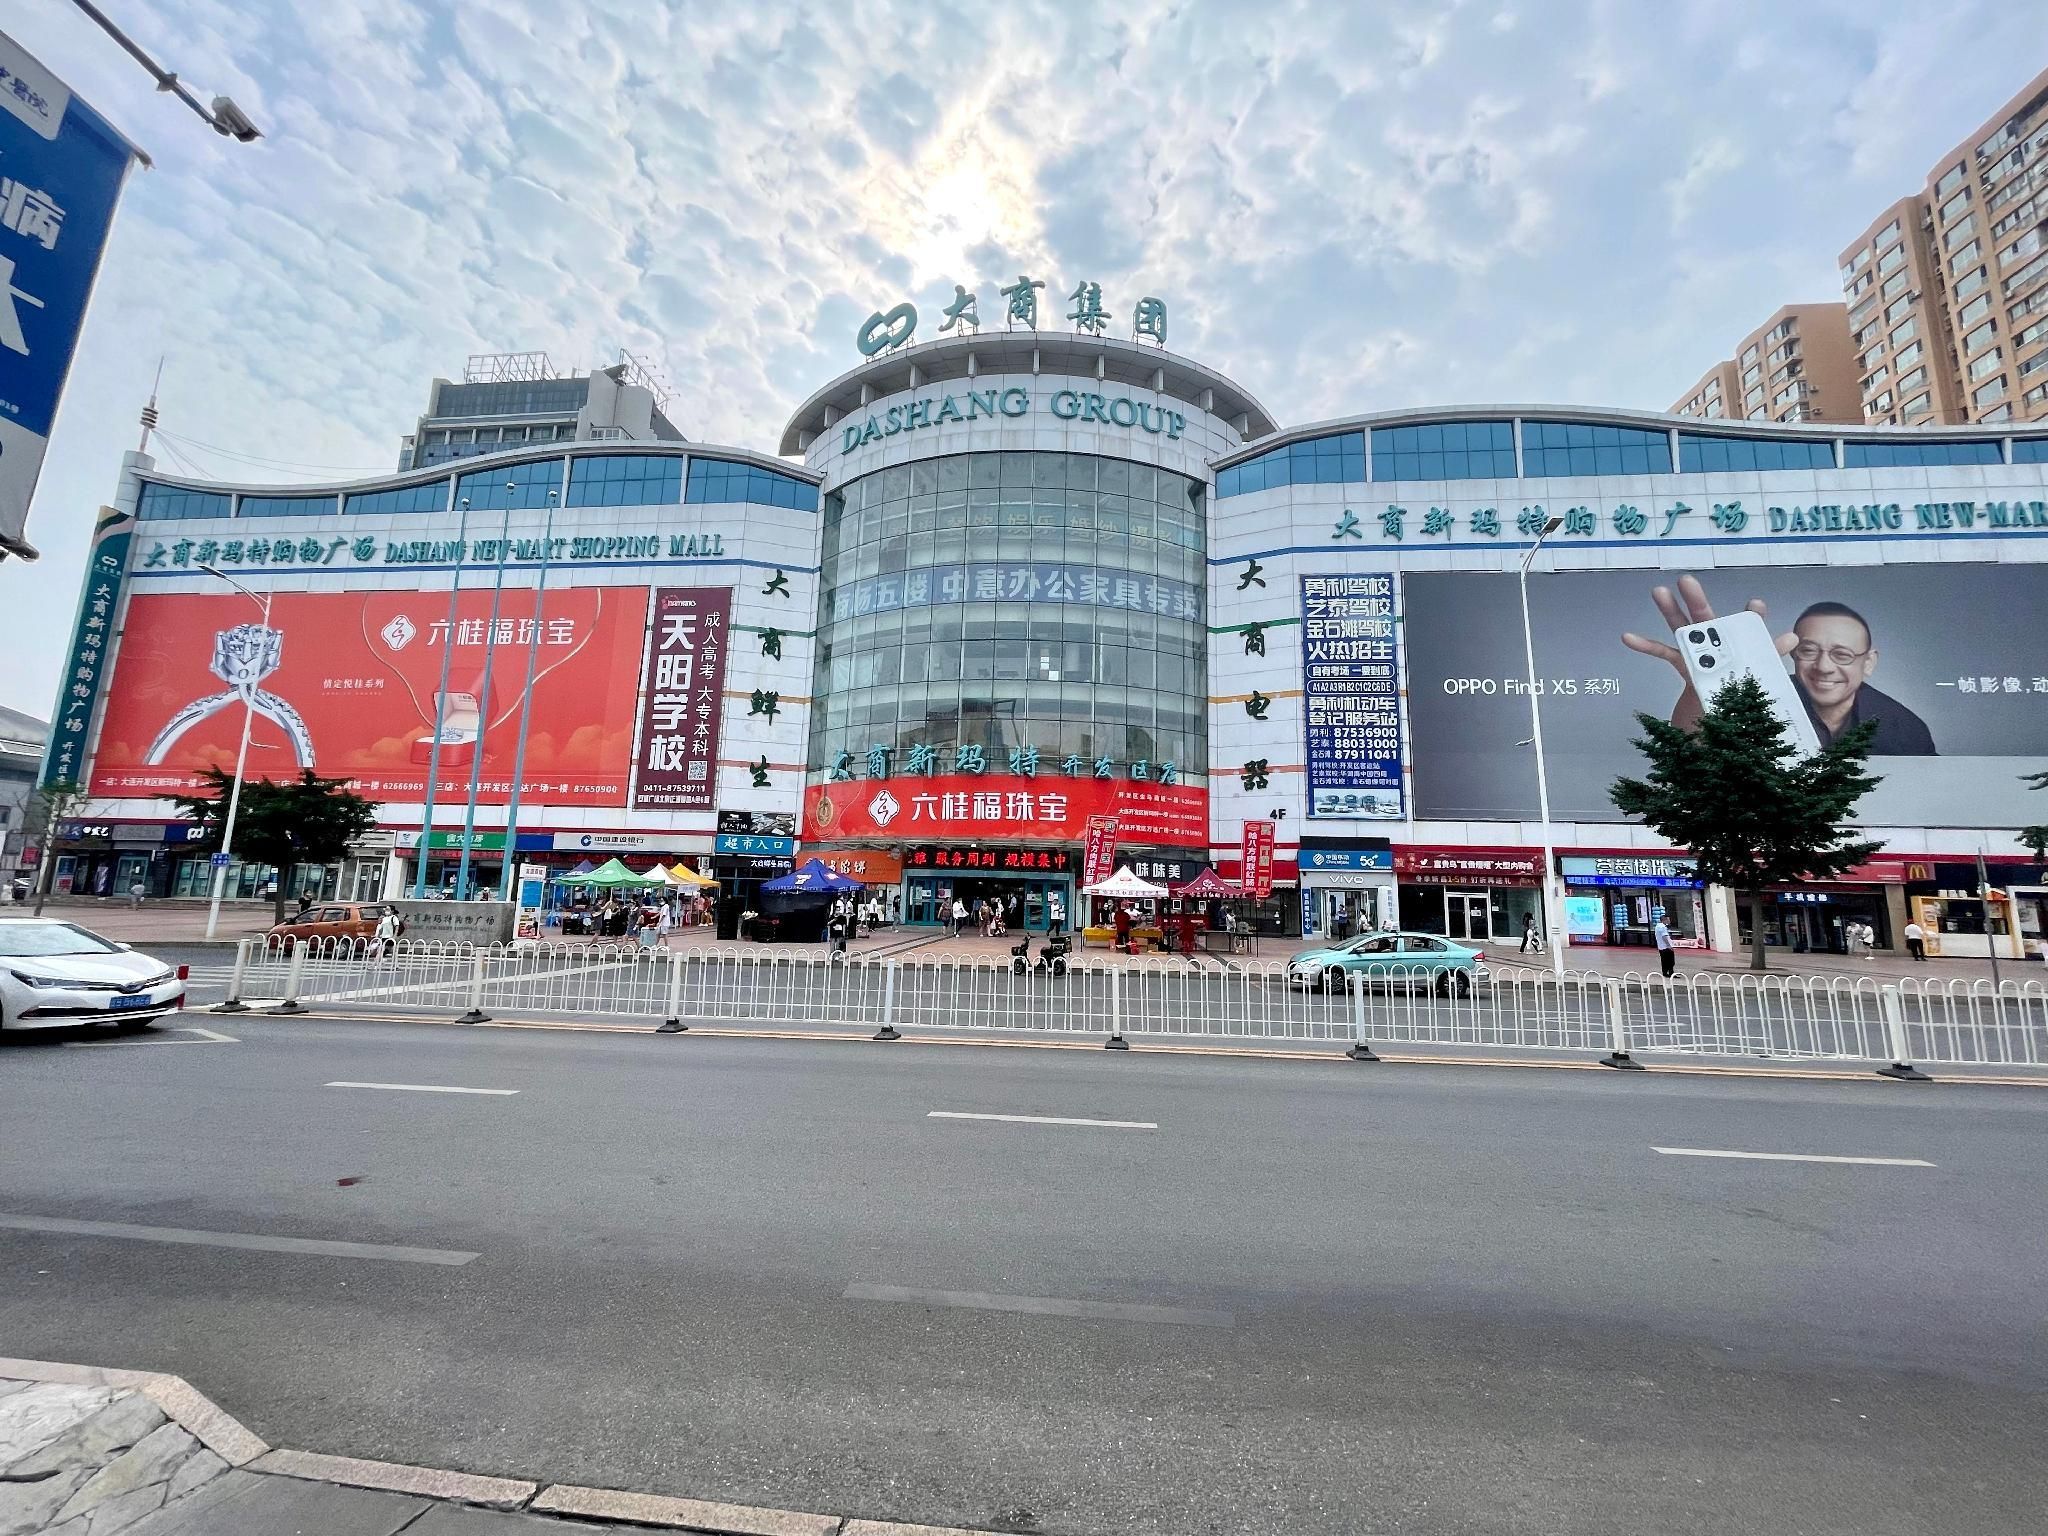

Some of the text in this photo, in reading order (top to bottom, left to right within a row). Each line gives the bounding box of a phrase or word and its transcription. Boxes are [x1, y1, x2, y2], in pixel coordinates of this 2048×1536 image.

[938, 275, 1167, 344] 大商集团
[842, 387, 1187, 455] DASHANG GROUP
[1332, 501, 1749, 541] 大商新玛特购物广场
[1769, 503, 1903, 532] DASHANG
[143, 533, 725, 568] 大商新玛特购物广场 DASHANG NEW-MART SHOPPING MALL
[1305, 577, 1391, 597] 勇利驾校
[1306, 598, 1391, 618] 艺泰驾校
[427, 617, 576, 646] 六桂福珠宝
[1307, 619, 1392, 639] 金石滩驾校
[64, 583, 111, 732] 大商新玛特购物广场
[1308, 640, 1393, 661] 火热招生
[1237, 559, 1271, 792] 大商电器
[648, 614, 697, 772] 天阳学校
[1443, 678, 1620, 695] OPPO Find X5 系列
[1309, 696, 1396, 711] 勇利机动车
[1309, 711, 1398, 726] 登记服务站
[1333, 728, 1397, 738] 87536900
[1334, 739, 1398, 749] 88033000
[1334, 750, 1397, 760] 87911041
[383, 782, 424, 790] 62666969
[573, 784, 618, 793] 87650900
[911, 791, 1068, 822] 六桂福珠宝
[1269, 809, 1287, 819] 4F
[723, 837, 784, 850] 超市入口
[935, 852, 995, 867] 服务周到
[1004, 852, 1067, 869] 规模集中
[1359, 855, 1375, 867] 5G
[1136, 862, 1181, 879] 味味美
[1329, 873, 1364, 883] vivo
